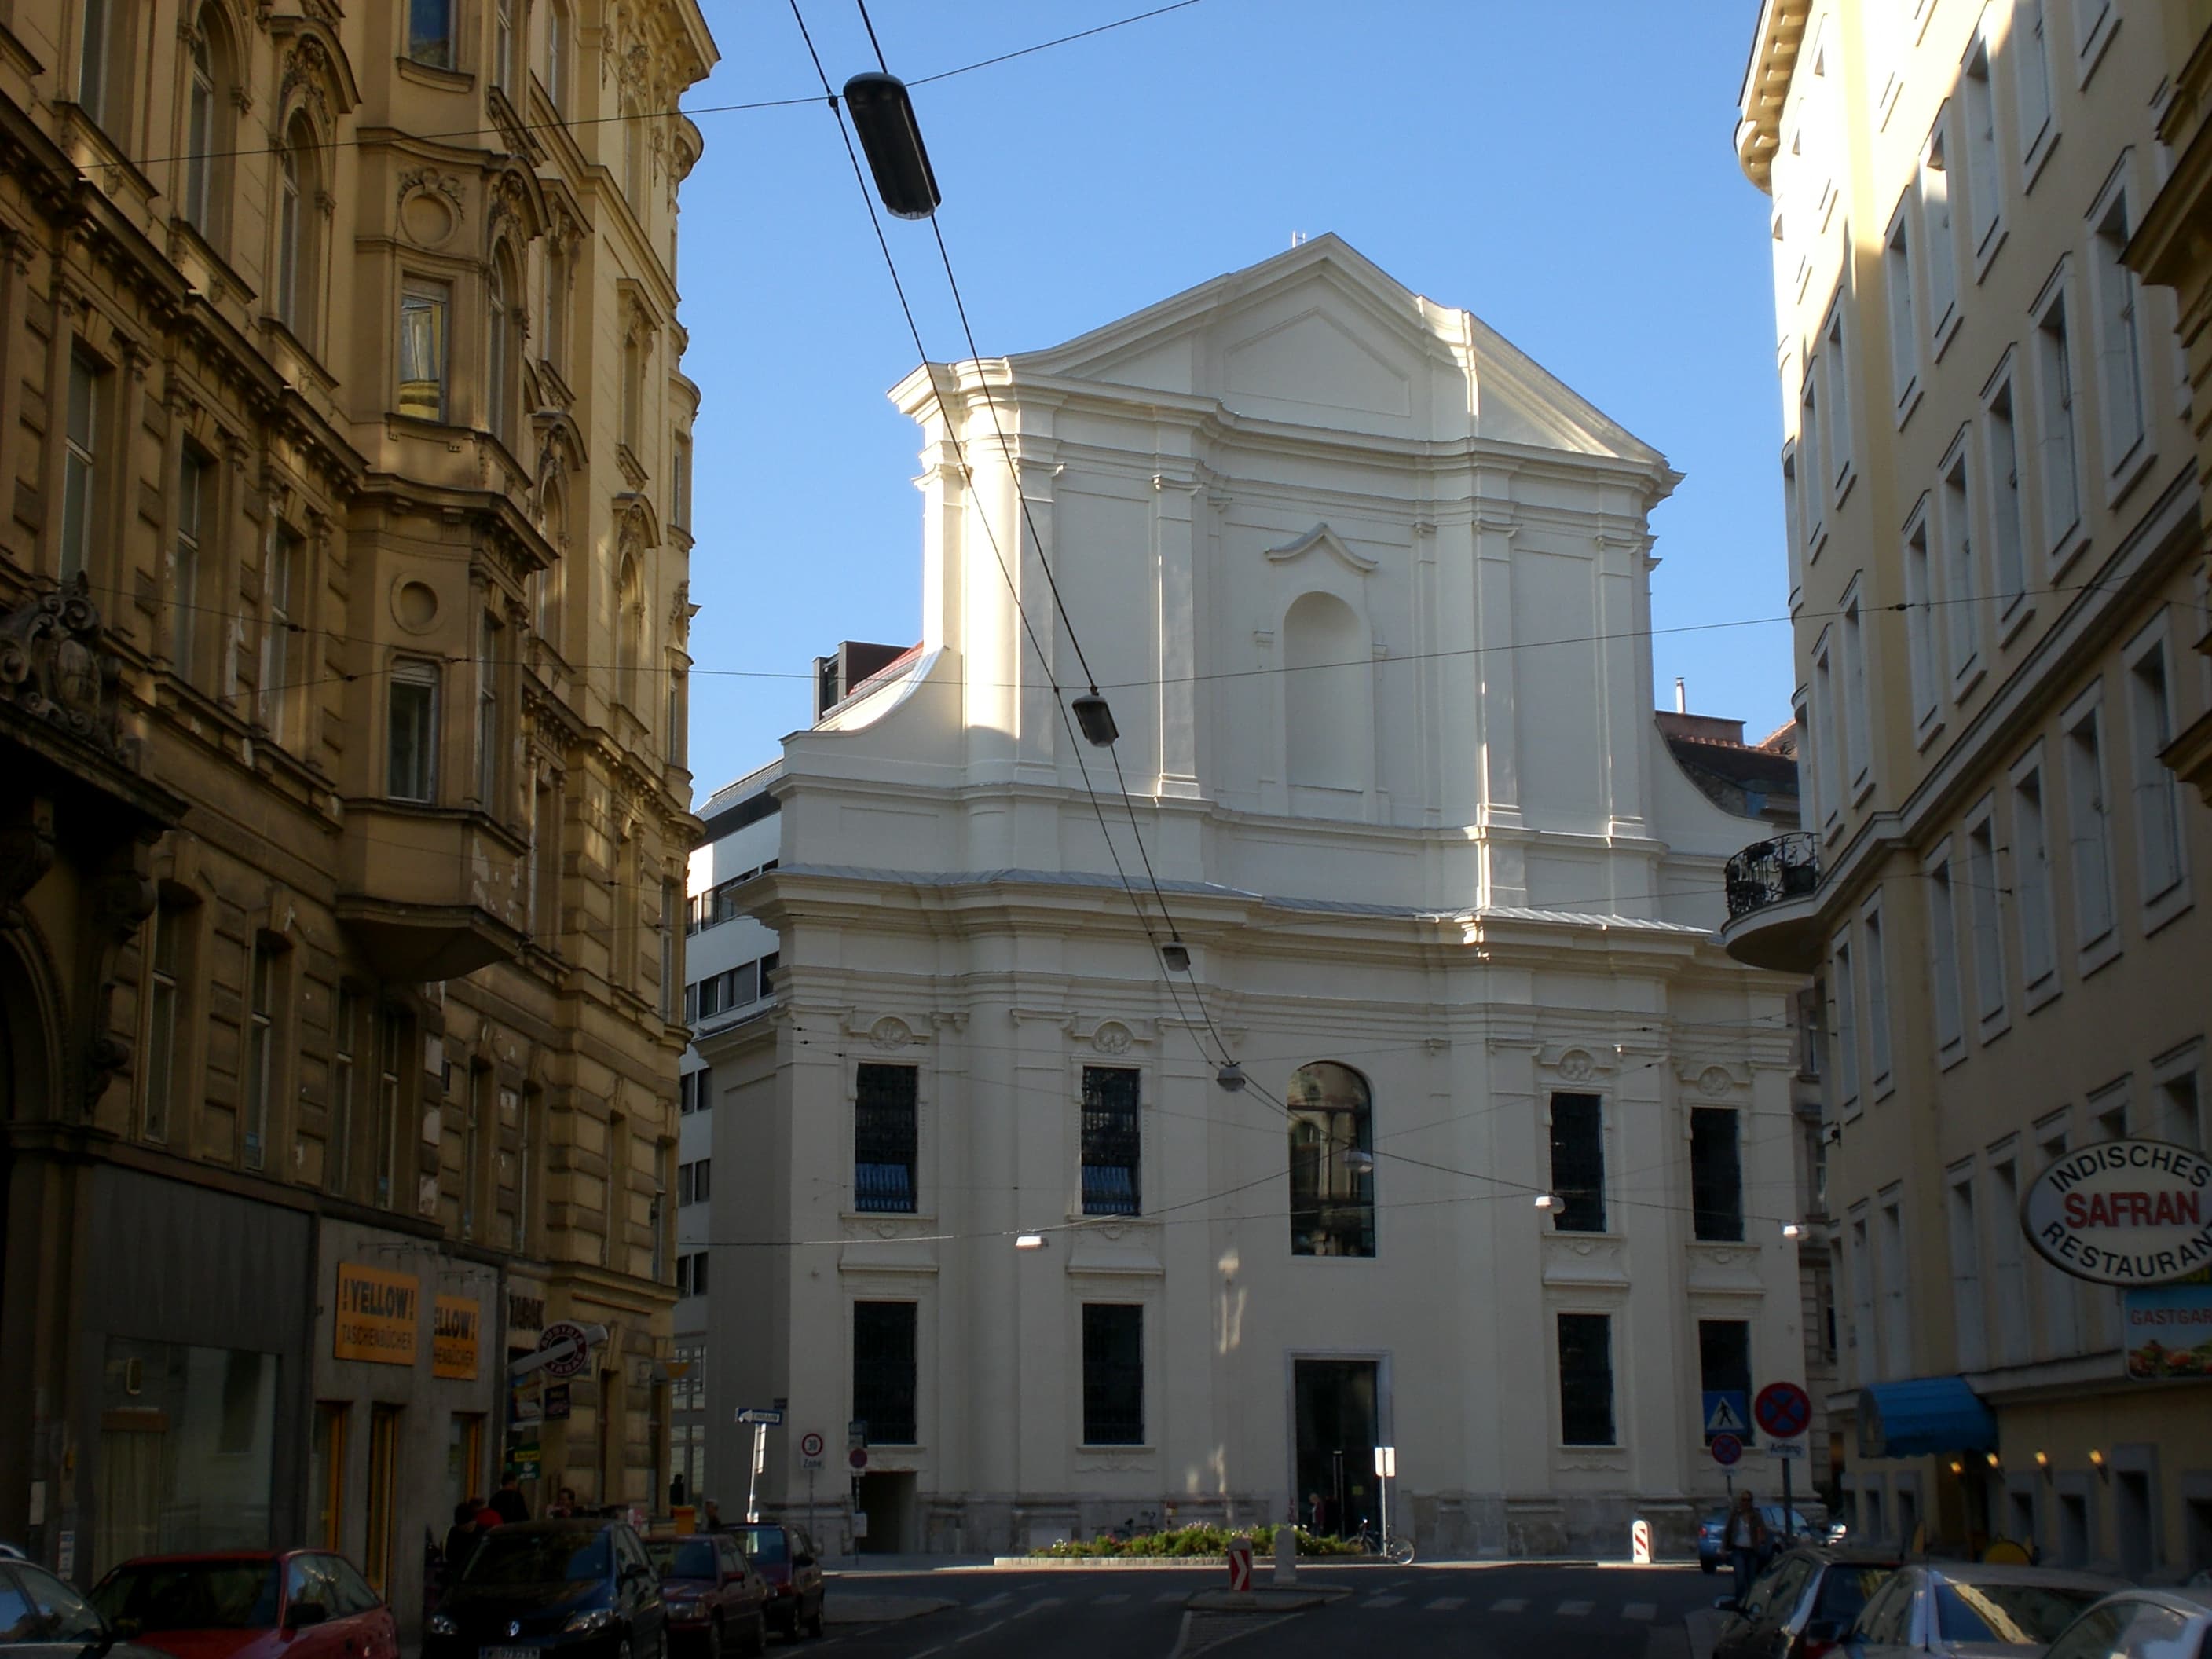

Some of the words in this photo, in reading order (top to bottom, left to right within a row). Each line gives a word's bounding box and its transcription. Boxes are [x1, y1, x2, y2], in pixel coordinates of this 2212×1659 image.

[2049, 1145, 2210, 1192] INDISCHES
[2064, 1190, 2200, 1229] SAFRAN
[342, 1277, 415, 1320] !YELLOW!
